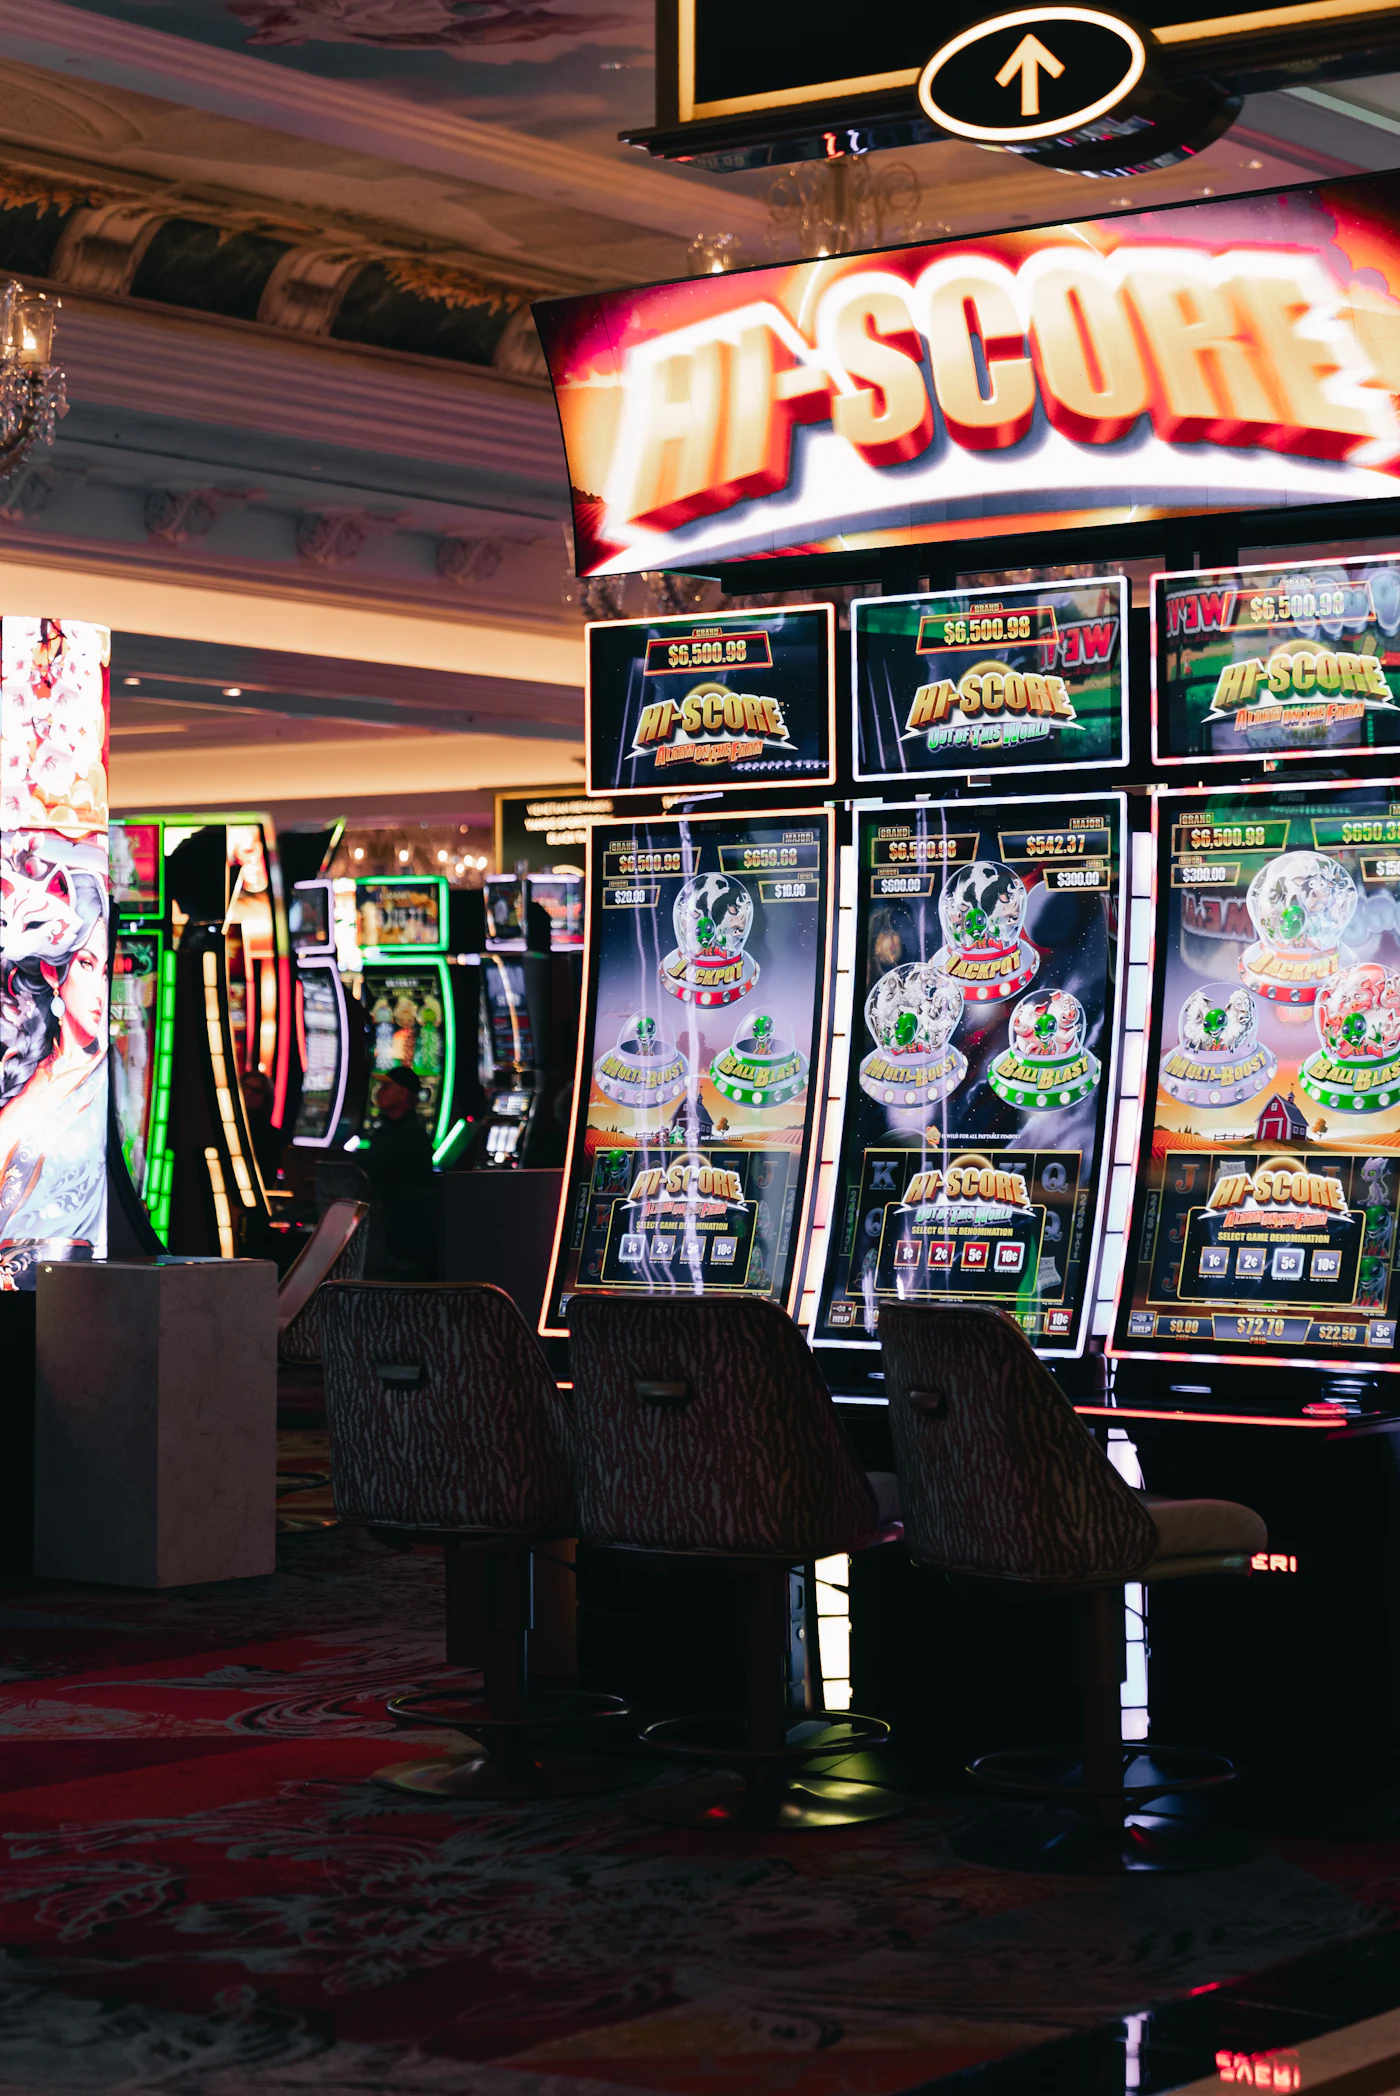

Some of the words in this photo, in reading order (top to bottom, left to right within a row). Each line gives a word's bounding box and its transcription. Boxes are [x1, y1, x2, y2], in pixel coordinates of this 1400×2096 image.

[622, 256, 1387, 530] HI-SCORE
[974, 604, 1000, 613] GRAND
[1250, 591, 1345, 622] $6,500.98
[943, 615, 1031, 645] $6,500.98
[668, 639, 747, 668] $6,500.98
[1213, 654, 1390, 710] HI-SCORE
[908, 674, 1074, 728] HI-SCORE
[636, 695, 788, 745] HI-SCORE
[1234, 706, 1282, 732] ALARM
[1300, 706, 1326, 726] THE
[1325, 703, 1365, 726] FARM
[927, 726, 955, 750] OUT
[954, 728, 970, 745] OF
[972, 725, 1002, 748] THIS
[1002, 721, 1051, 746] WORLD
[654, 743, 696, 767] ALARM
[695, 745, 711, 762] ON
[711, 743, 731, 761] THE
[730, 741, 764, 763] FARM
[1072, 818, 1101, 829] MAJOR
[1182, 814, 1212, 825] GRAND
[785, 833, 811, 843] MAJOR
[880, 828, 908, 838] GRAND
[1191, 827, 1266, 849] $6,500.98
[611, 842, 637, 852] GRAND
[888, 840, 957, 862] $6,500.98
[1026, 834, 1086, 856] $542.37
[618, 853, 681, 874] $6,500.98
[743, 847, 798, 869] $659.68
[880, 877, 921, 893] $600.00
[1056, 871, 1100, 887] $300.00
[1182, 866, 1226, 883] $300.00
[614, 889, 645, 904] $20.00
[774, 883, 807, 898] $10.00
[667, 959, 745, 987] JACKPOT
[944, 949, 1022, 982] JACKPOT
[1247, 952, 1340, 982] JACKPOT
[600, 1057, 685, 1089] MULTI-BOOST
[718, 1055, 755, 1081] BALL
[753, 1056, 801, 1088] BLAST
[864, 1053, 959, 1088] MULTI-BOOST
[997, 1057, 1038, 1082] BALL
[1037, 1055, 1090, 1090] BLAST
[1164, 1051, 1267, 1087] MULTI-BOOST
[1308, 1058, 1354, 1085] BALL
[1353, 1060, 1400, 1092] BLAS
[629, 1166, 742, 1200] HI-SCORE
[757, 1161, 779, 1190] J
[869, 1161, 899, 1190] K
[1041, 1162, 1069, 1194] Q
[1175, 1164, 1200, 1194] J
[904, 1169, 1030, 1207] HI-SCORE
[1209, 1172, 1346, 1210] HI-SCORE
[636, 1221, 659, 1230] SELECT
[659, 1221, 679, 1230] GAME
[678, 1222, 729, 1231] DENOMINATION
[916, 1206, 938, 1223] OUT
[937, 1207, 949, 1221] OF
[950, 1206, 975, 1224] THIS
[974, 1206, 1013, 1224] WORLD
[1223, 1210, 1264, 1228] ALARM
[1294, 1212, 1328, 1230] FARM
[911, 1226, 937, 1235] SELECT
[937, 1226, 958, 1236] GAME
[958, 1227, 1014, 1237] DENOMINATION
[1217, 1232, 1246, 1242] SELECT
[1246, 1232, 1270, 1242] GAME
[1269, 1232, 1330, 1244] DENOMINATION
[656, 1242, 668, 1254] 2¢
[716, 1243, 732, 1256] 10¢
[902, 1246, 913, 1259] 1¢
[934, 1247, 947, 1261] 2¢
[968, 1248, 982, 1261] 5¢
[1001, 1248, 1018, 1263] 10¢
[1208, 1254, 1221, 1268] 1¢
[1243, 1255, 1258, 1269] 2¢
[1280, 1256, 1296, 1270] 5¢
[1317, 1257, 1336, 1271] 10¢
[832, 1315, 850, 1324] HELP
[1051, 1312, 1069, 1326] 10¢
[1132, 1325, 1151, 1334] HELP
[1169, 1319, 1200, 1334] $0.00
[1236, 1317, 1285, 1337] $72.70
[1318, 1325, 1357, 1341] $22.50
[1376, 1324, 1390, 1338] 5¢
[1251, 1552, 1297, 1573] ERI
